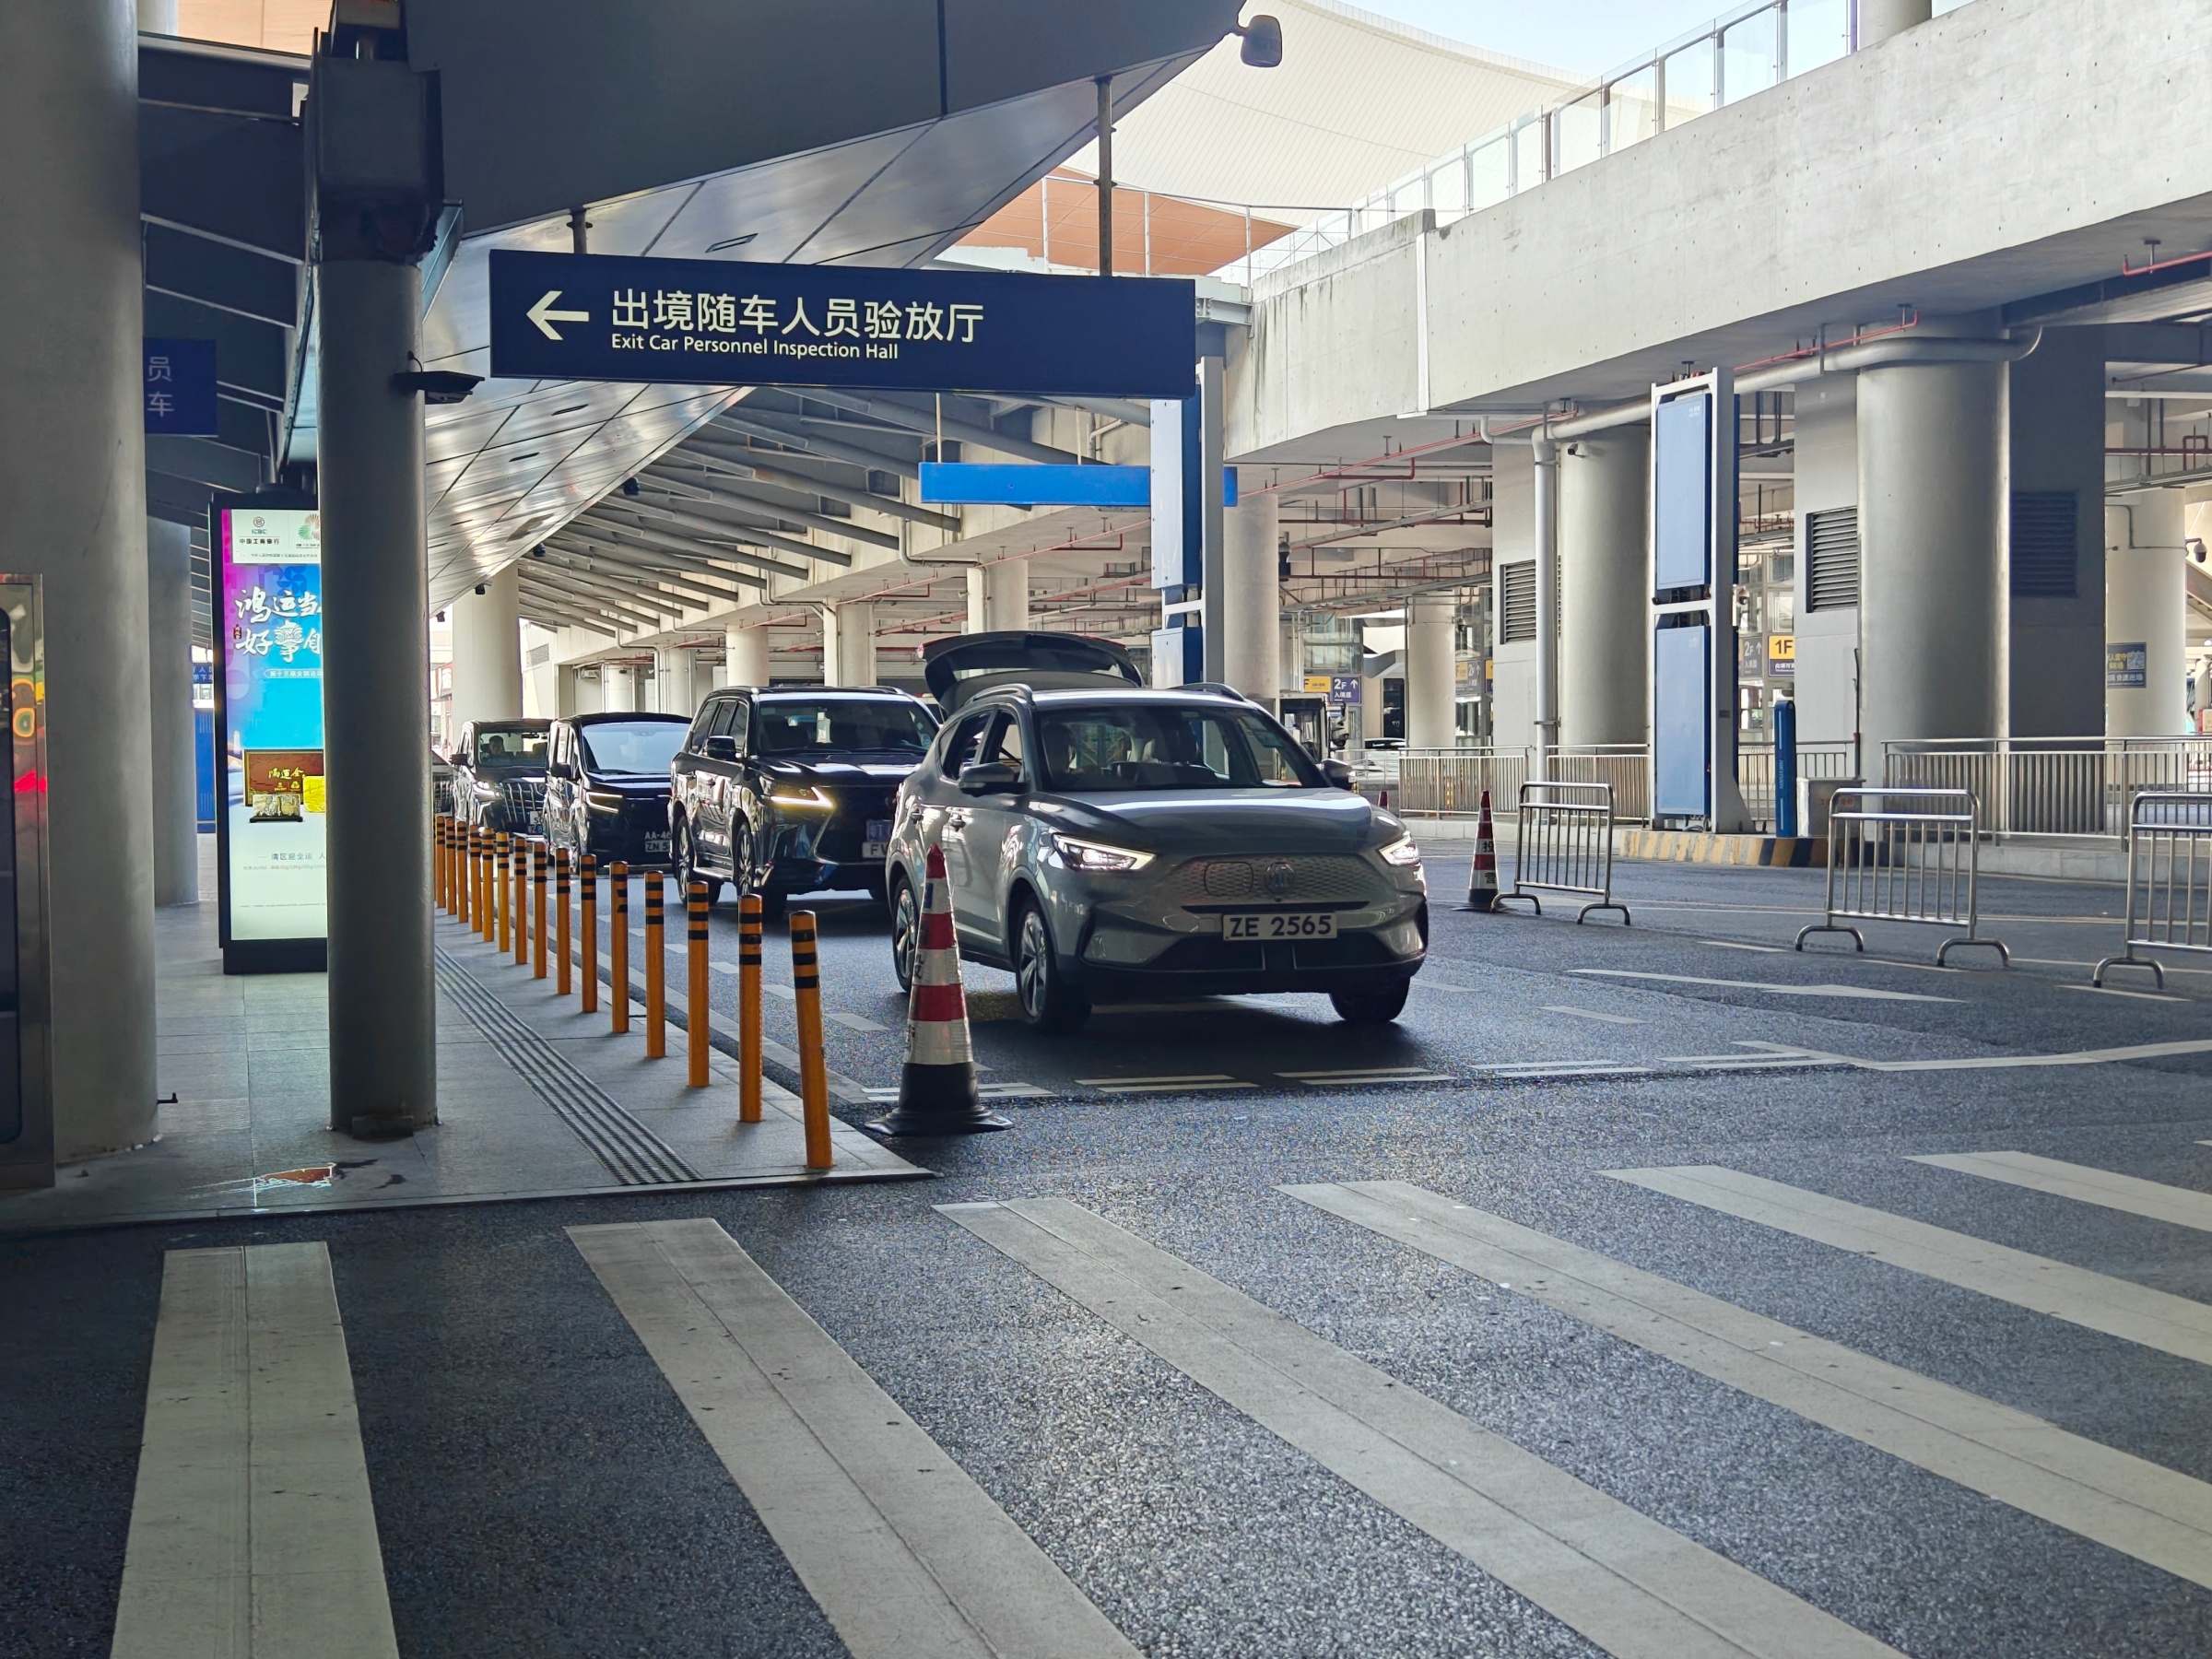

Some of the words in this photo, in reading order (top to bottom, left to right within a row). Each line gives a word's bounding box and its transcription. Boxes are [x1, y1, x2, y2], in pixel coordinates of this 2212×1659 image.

[612, 288, 984, 343] 出境随车人员验放厅
[611, 333, 644, 349] Exit
[649, 335, 678, 351] Car
[684, 335, 768, 355] Personnel
[773, 338, 860, 359] Inspection
[866, 343, 899, 359] Hall
[147, 356, 172, 382] 员
[147, 391, 174, 418] 车
[234, 585, 322, 624] 鸿运当
[1744, 641, 1754, 657] 2F
[1774, 640, 1794, 654] 1F
[1334, 678, 1347, 689] 2F
[1230, 917, 1260, 937] ZE
[1270, 915, 1332, 936] 2565
